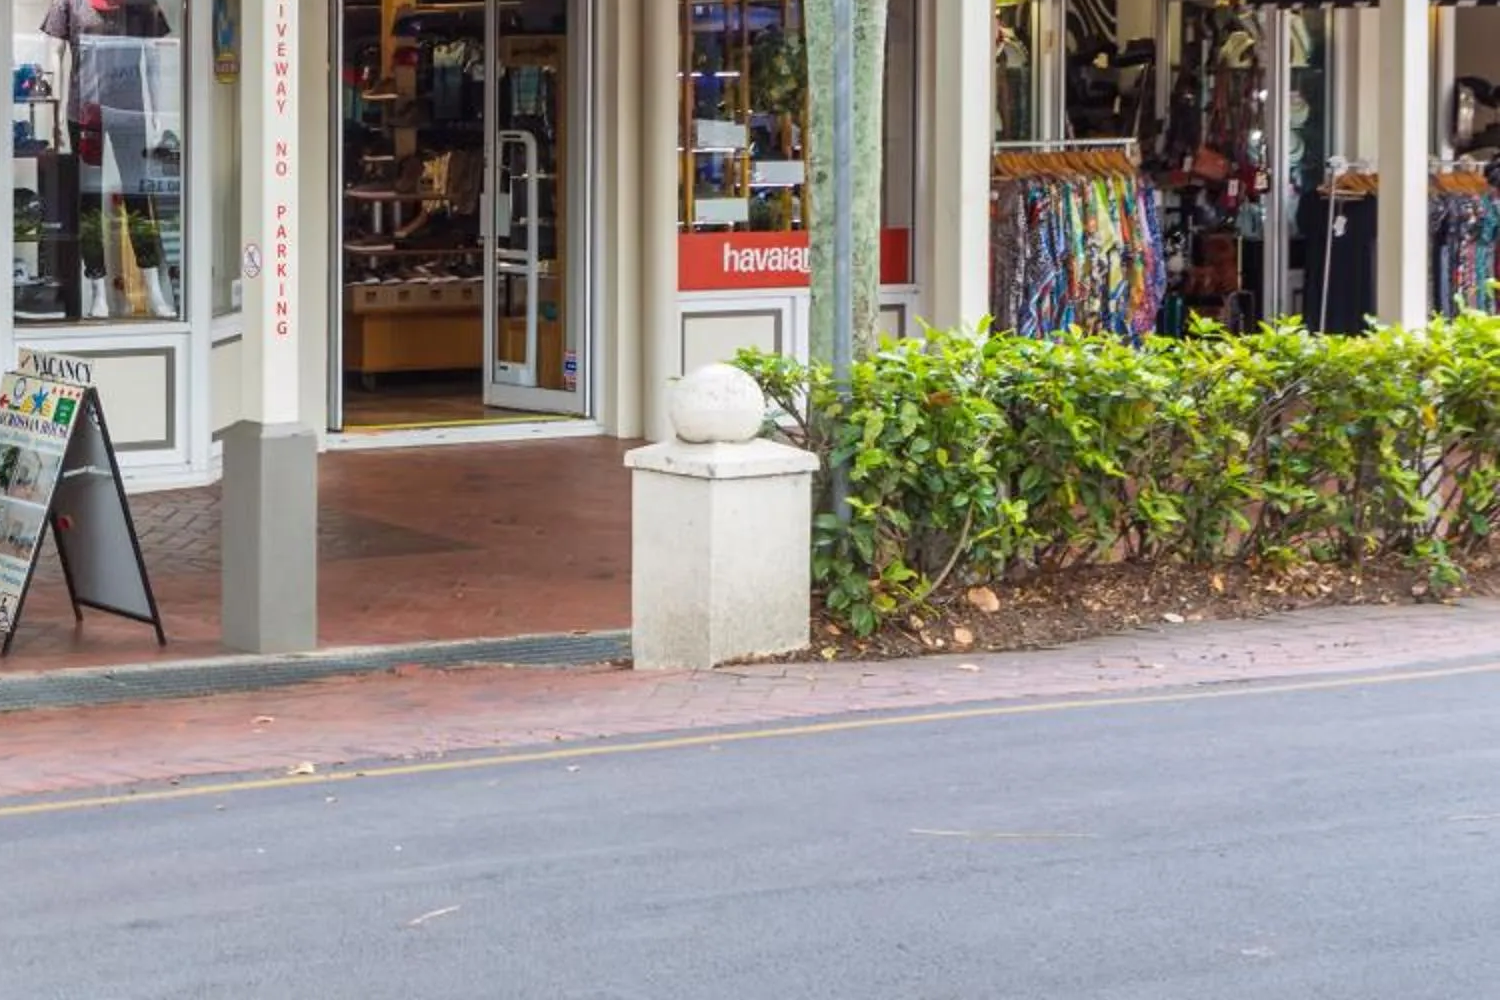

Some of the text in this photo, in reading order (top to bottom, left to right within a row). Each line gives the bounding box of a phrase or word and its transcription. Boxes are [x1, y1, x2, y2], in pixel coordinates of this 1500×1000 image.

[276, 142, 288, 176] NO
[276, 205, 288, 336] PARKING
[723, 242, 811, 273] havaia
[32, 352, 92, 384] VACANCY
